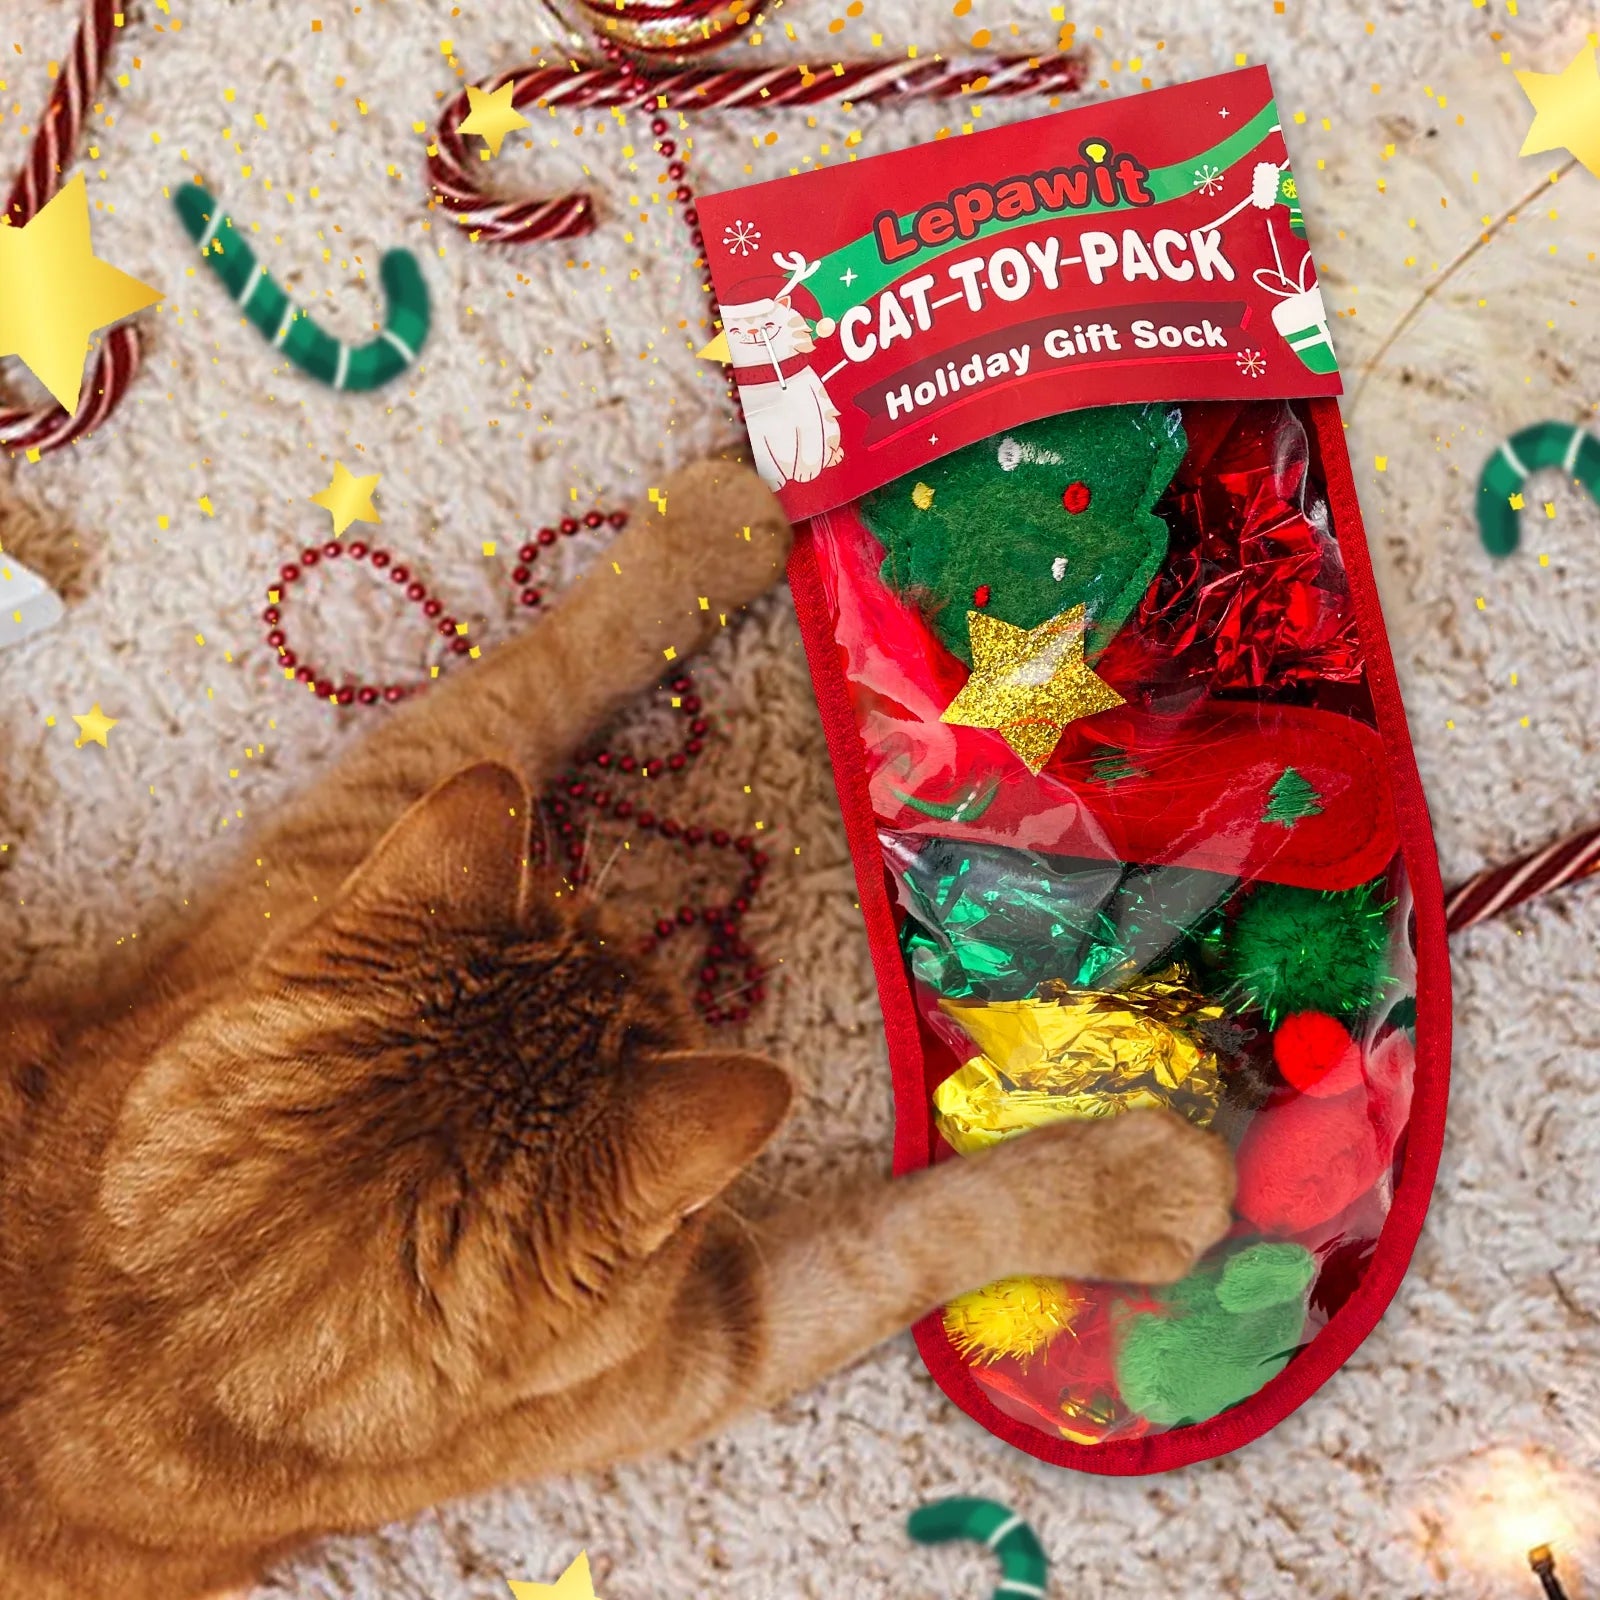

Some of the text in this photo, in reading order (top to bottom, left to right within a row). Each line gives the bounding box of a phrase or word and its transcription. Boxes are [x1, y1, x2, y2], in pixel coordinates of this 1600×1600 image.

[875, 139, 1154, 263] Lepawit
[1081, 228, 1236, 285] PACK
[885, 320, 1228, 421] Holiday Gift Sock
